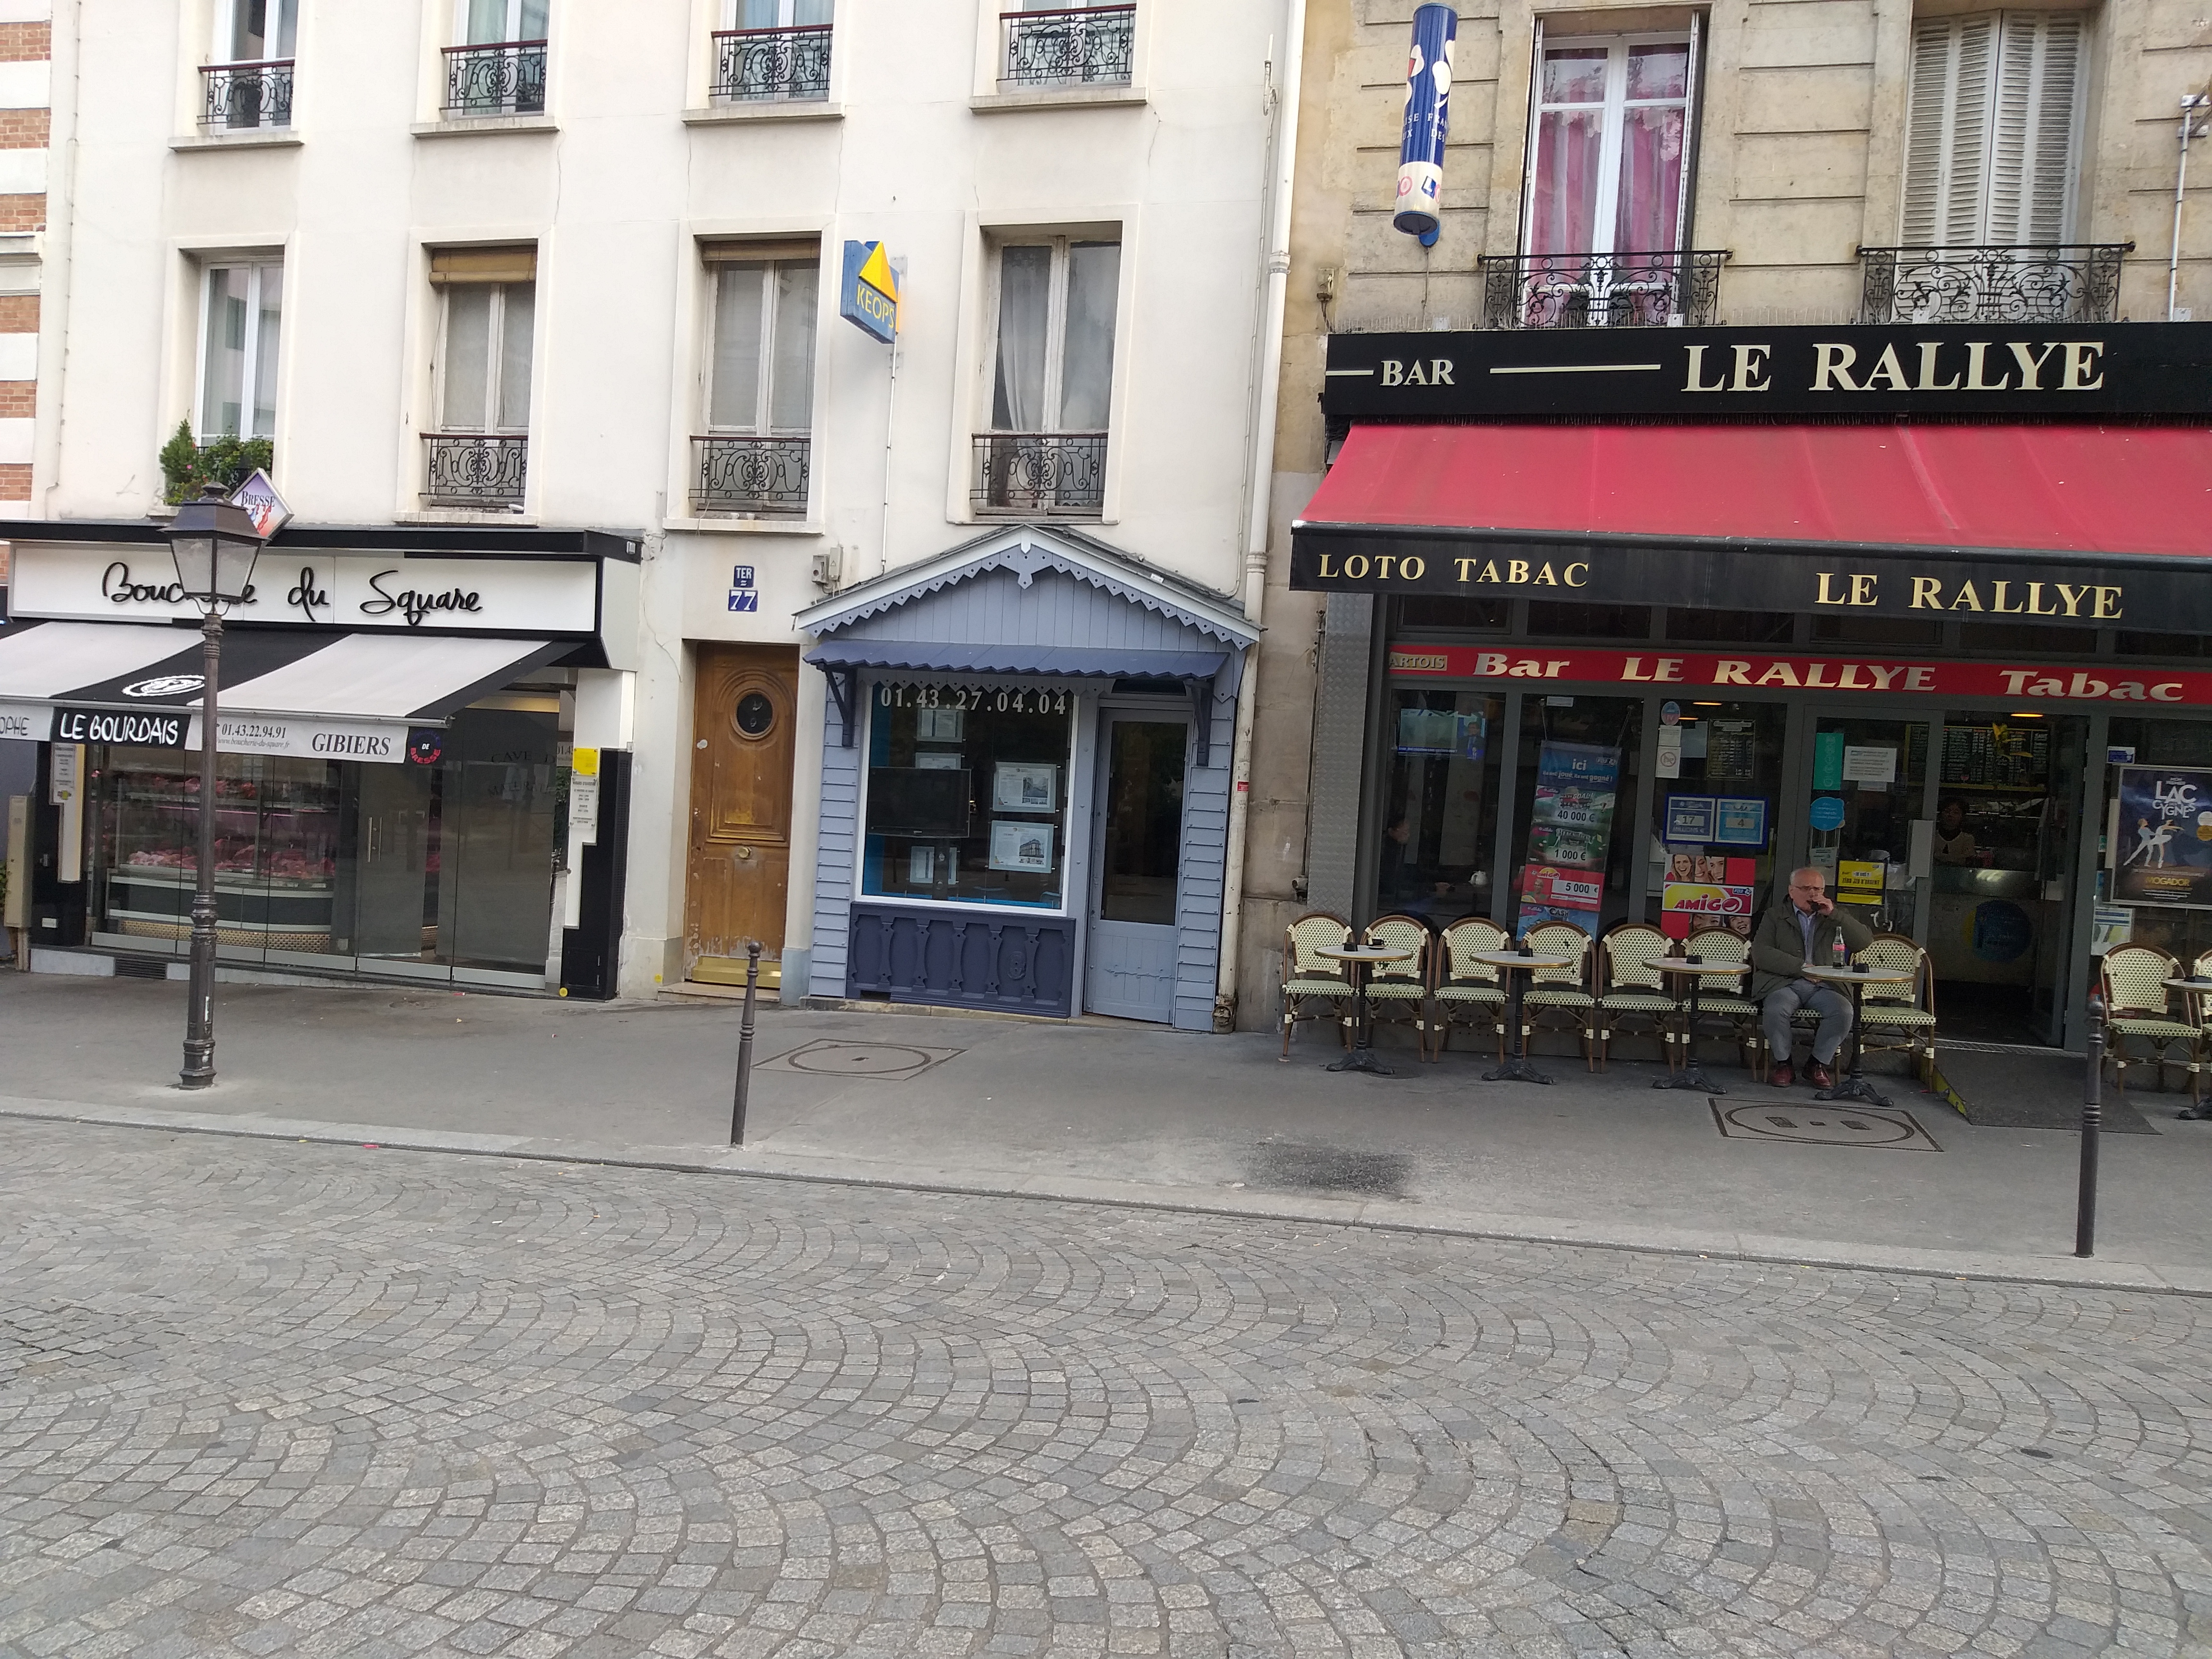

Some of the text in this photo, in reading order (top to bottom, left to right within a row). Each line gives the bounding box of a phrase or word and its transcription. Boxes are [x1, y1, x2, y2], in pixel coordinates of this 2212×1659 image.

[857, 284, 894, 328] KEOPS
[1380, 360, 1455, 386] BAR
[1681, 341, 2104, 393] LE RALLYE
[241, 491, 275, 507] BRESSE
[736, 567, 752, 579] TER
[1318, 553, 1588, 588] LOTO TABAC
[288, 566, 330, 622] du
[360, 570, 483, 625] Square
[730, 591, 756, 610] 77
[1815, 572, 2123, 620] LE RALLYE
[1389, 657, 1445, 669] ARTOIS
[1472, 653, 1937, 692] Bar LE RALLYE
[1999, 670, 2185, 702] Tabac
[881, 687, 1066, 715] 01.43.27.04.04
[60, 712, 179, 745] LE BOURDAIS
[222, 723, 286, 738] 01.43.22.94.91
[312, 733, 391, 755] GIBIERS
[1572, 758, 1587, 771] ici
[2155, 781, 2197, 805] LAC
[1558, 810, 1568, 819] 40
[1571, 811, 1587, 821] 000
[2152, 800, 2197, 820] CYGNES
[1682, 816, 1695, 824] 17
[1737, 818, 1744, 827] 4
[1562, 850, 1578, 860] 000
[1565, 882, 1571, 891] 5
[1574, 884, 1589, 893] 000
[2146, 877, 2190, 886] MOGADOR
[1549, 907, 1569, 916] CASH
[1674, 894, 1741, 912] AMIGO
